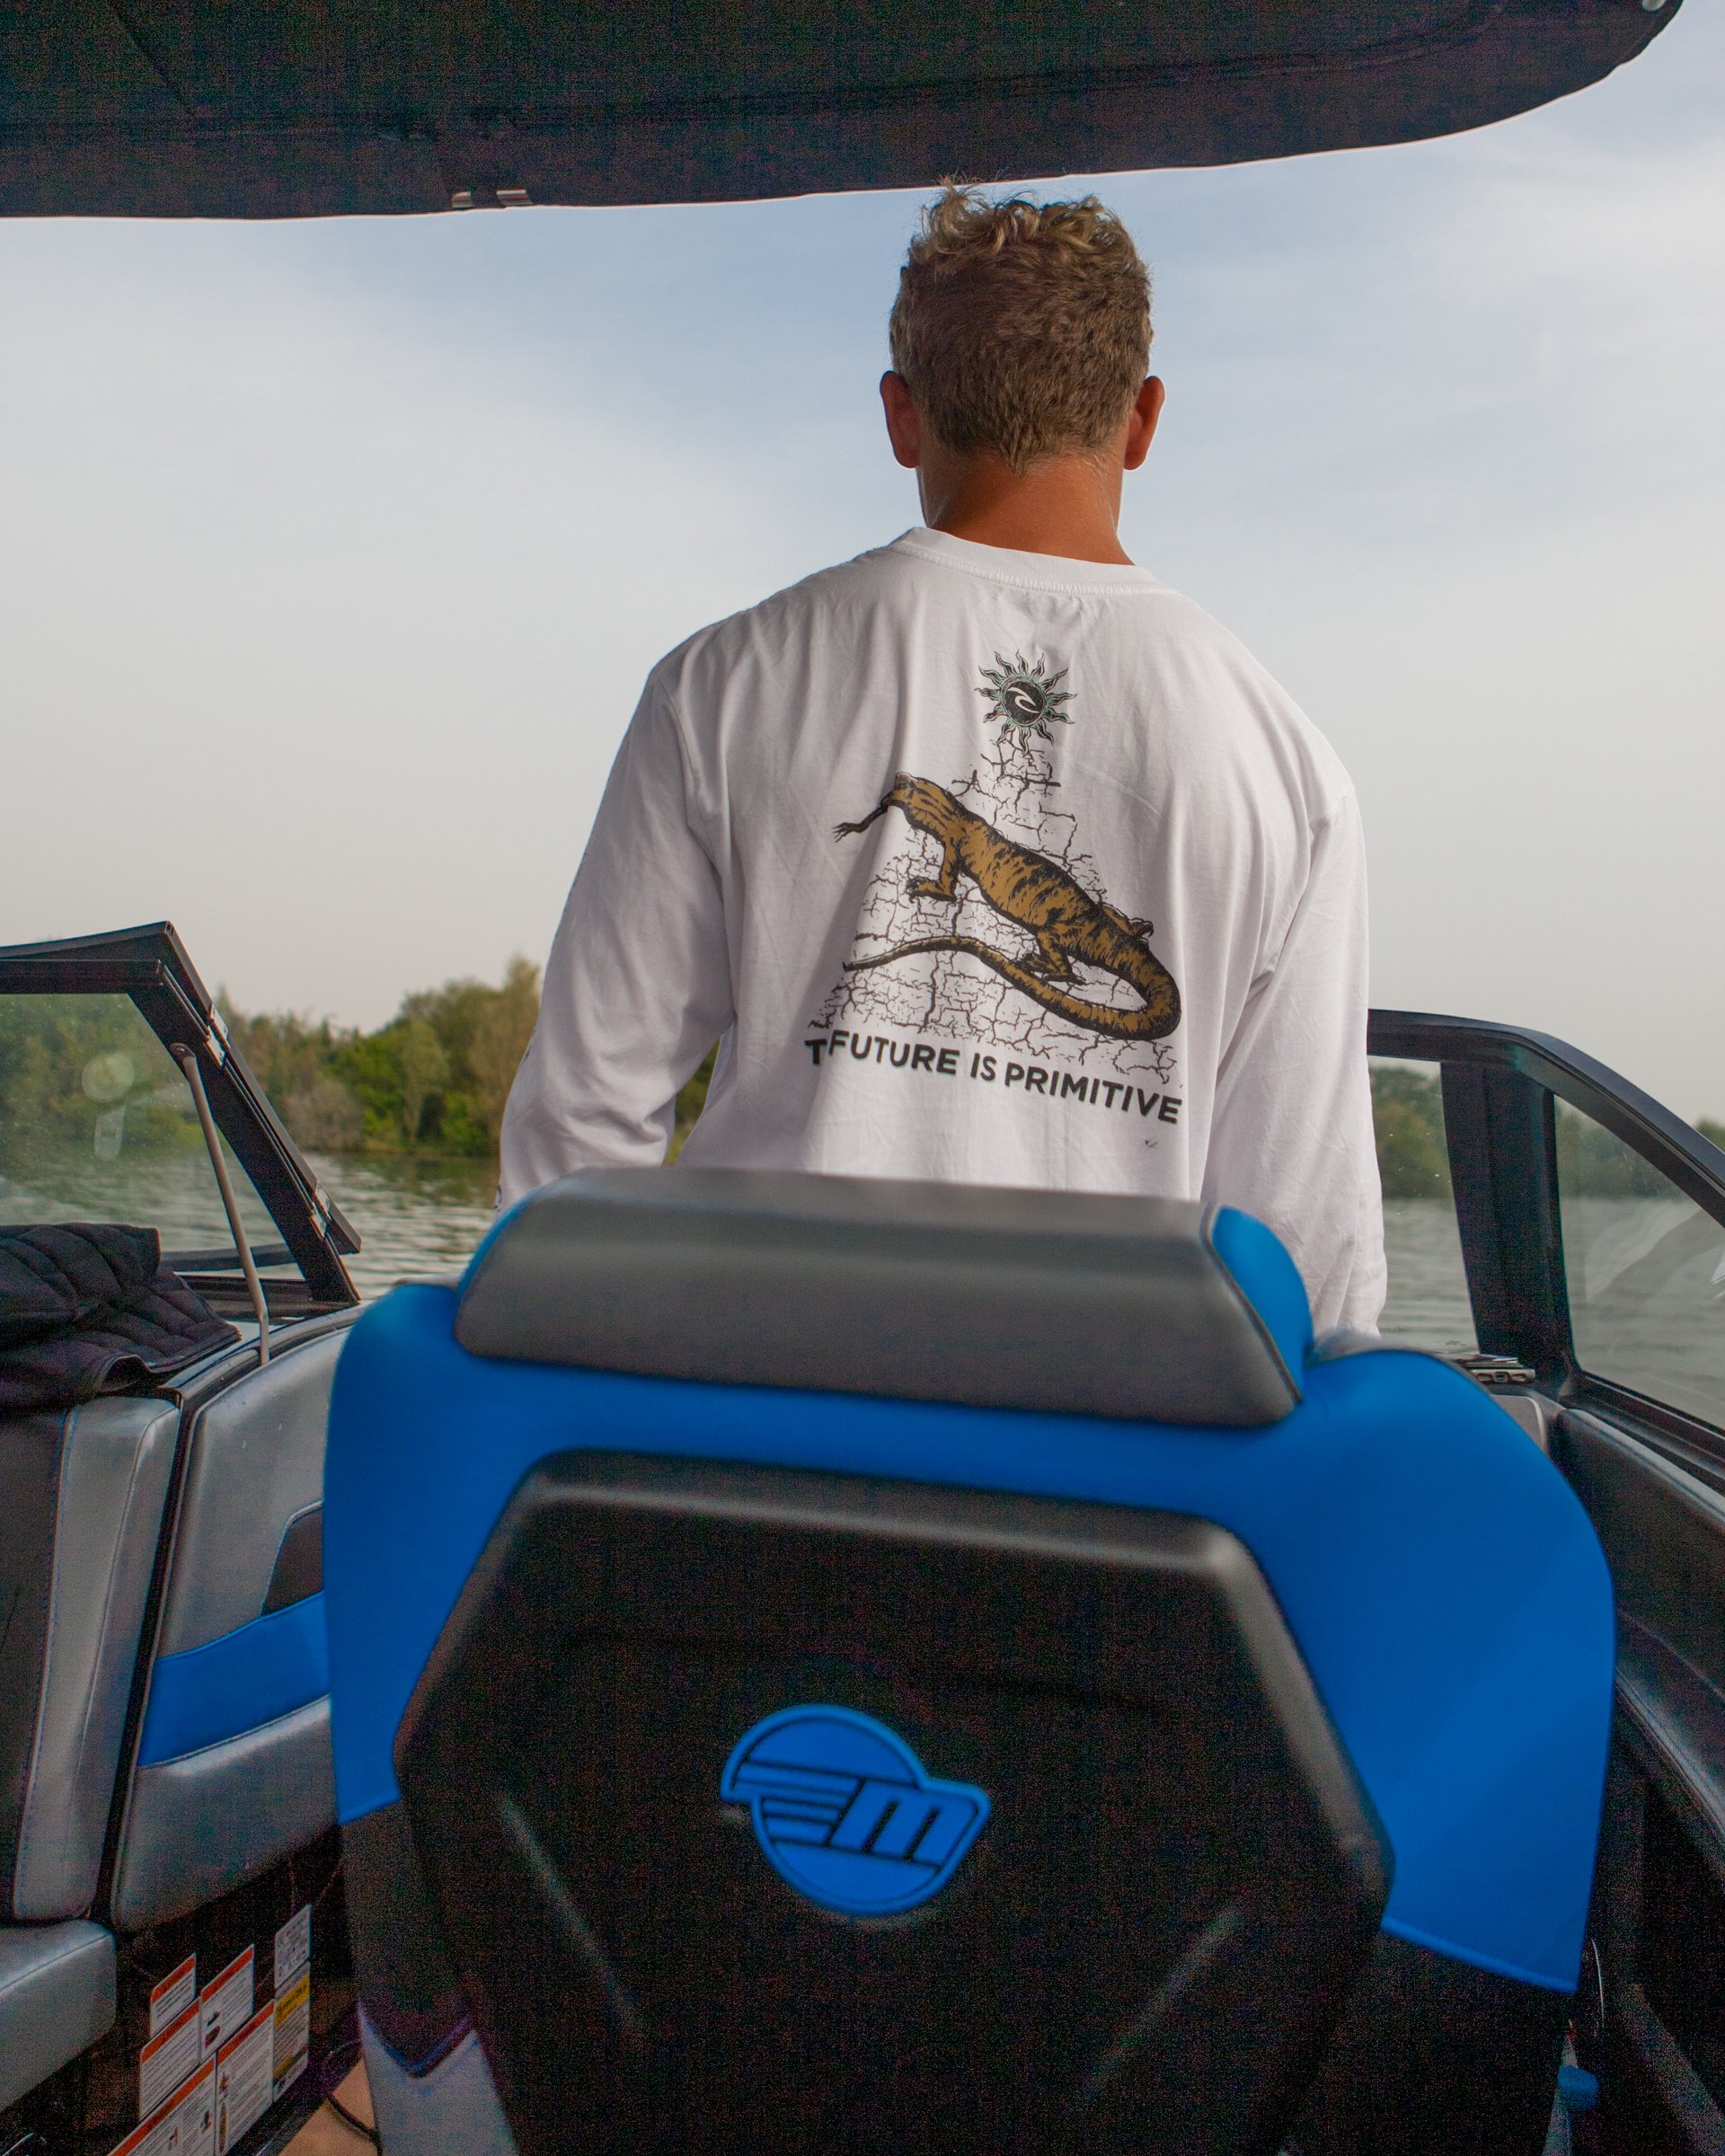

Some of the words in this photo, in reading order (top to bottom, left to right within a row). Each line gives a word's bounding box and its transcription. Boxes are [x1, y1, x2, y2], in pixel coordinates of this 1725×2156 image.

[828, 1029, 960, 1074] FUTURE
[970, 1052, 996, 1081] IS
[1004, 1062, 1182, 1123] PRIMITIVE
